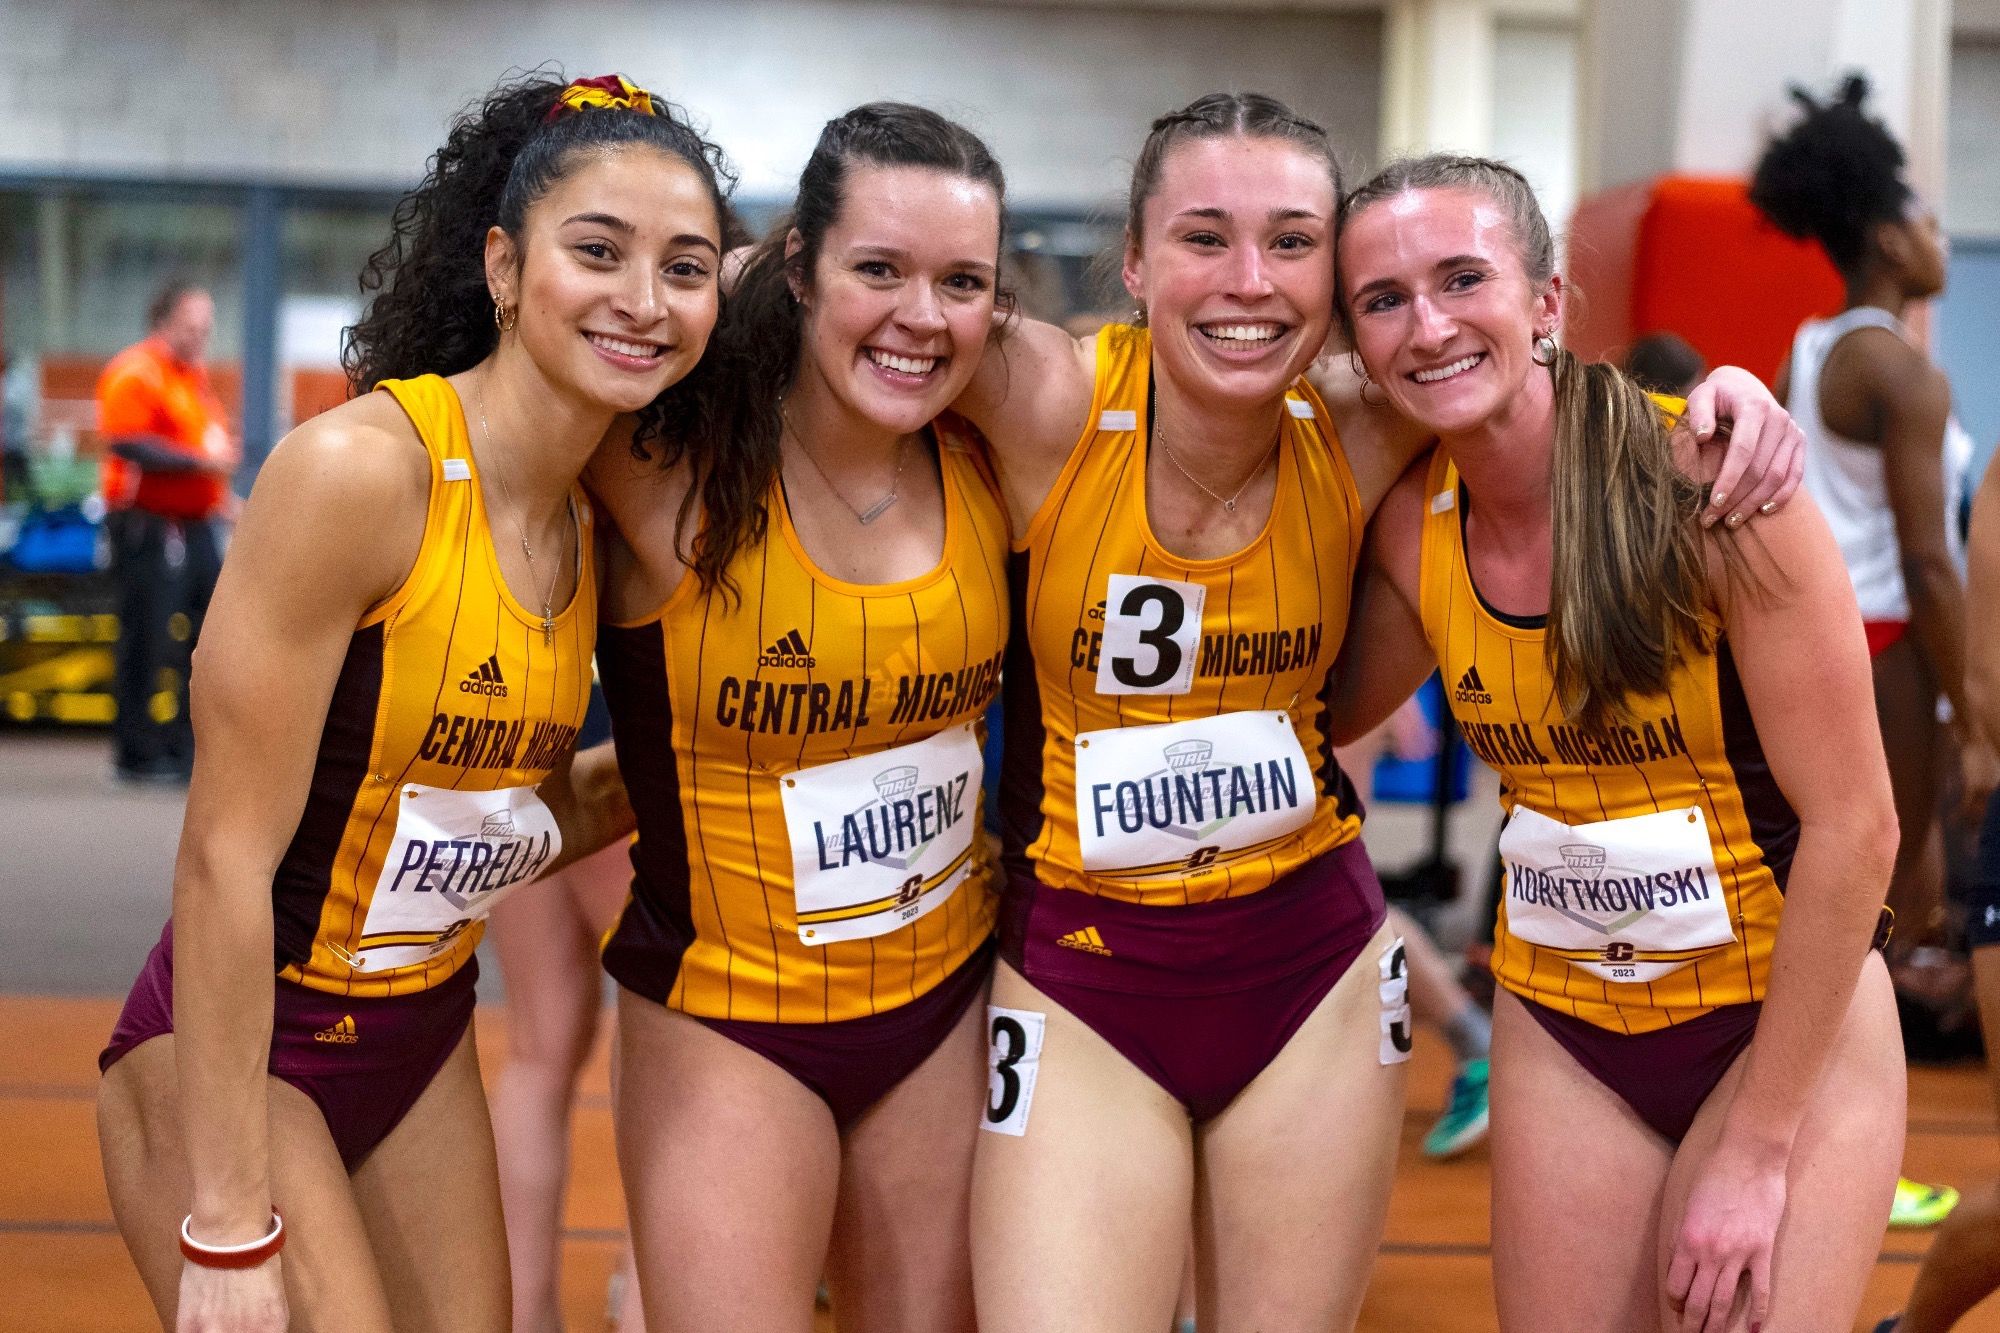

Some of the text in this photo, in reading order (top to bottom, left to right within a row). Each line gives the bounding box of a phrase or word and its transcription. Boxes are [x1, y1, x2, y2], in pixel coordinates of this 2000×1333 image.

[758, 653, 816, 669] adidas
[1111, 584, 1185, 688] 3
[1200, 623, 1323, 677] MICHIGAN
[459, 677, 508, 698] adidas
[716, 676, 871, 736] CENTRAL
[888, 650, 1002, 724] MICHIGA
[1455, 690, 1492, 705] adidas
[420, 712, 527, 770] CENTRAL
[1457, 714, 1688, 767] ENTRAL MICHIGAN
[813, 770, 969, 871] LAURENZ
[1092, 757, 1298, 837] FOUNTAIN
[390, 830, 550, 893] PETRELLA
[1511, 862, 1710, 912] KORYTKOWSKI
[901, 906, 919, 920] 2023
[1056, 939, 1112, 957] adidas
[1611, 968, 1636, 978] 2023
[314, 1031, 359, 1044] adidas
[987, 1015, 1026, 1123] 3
